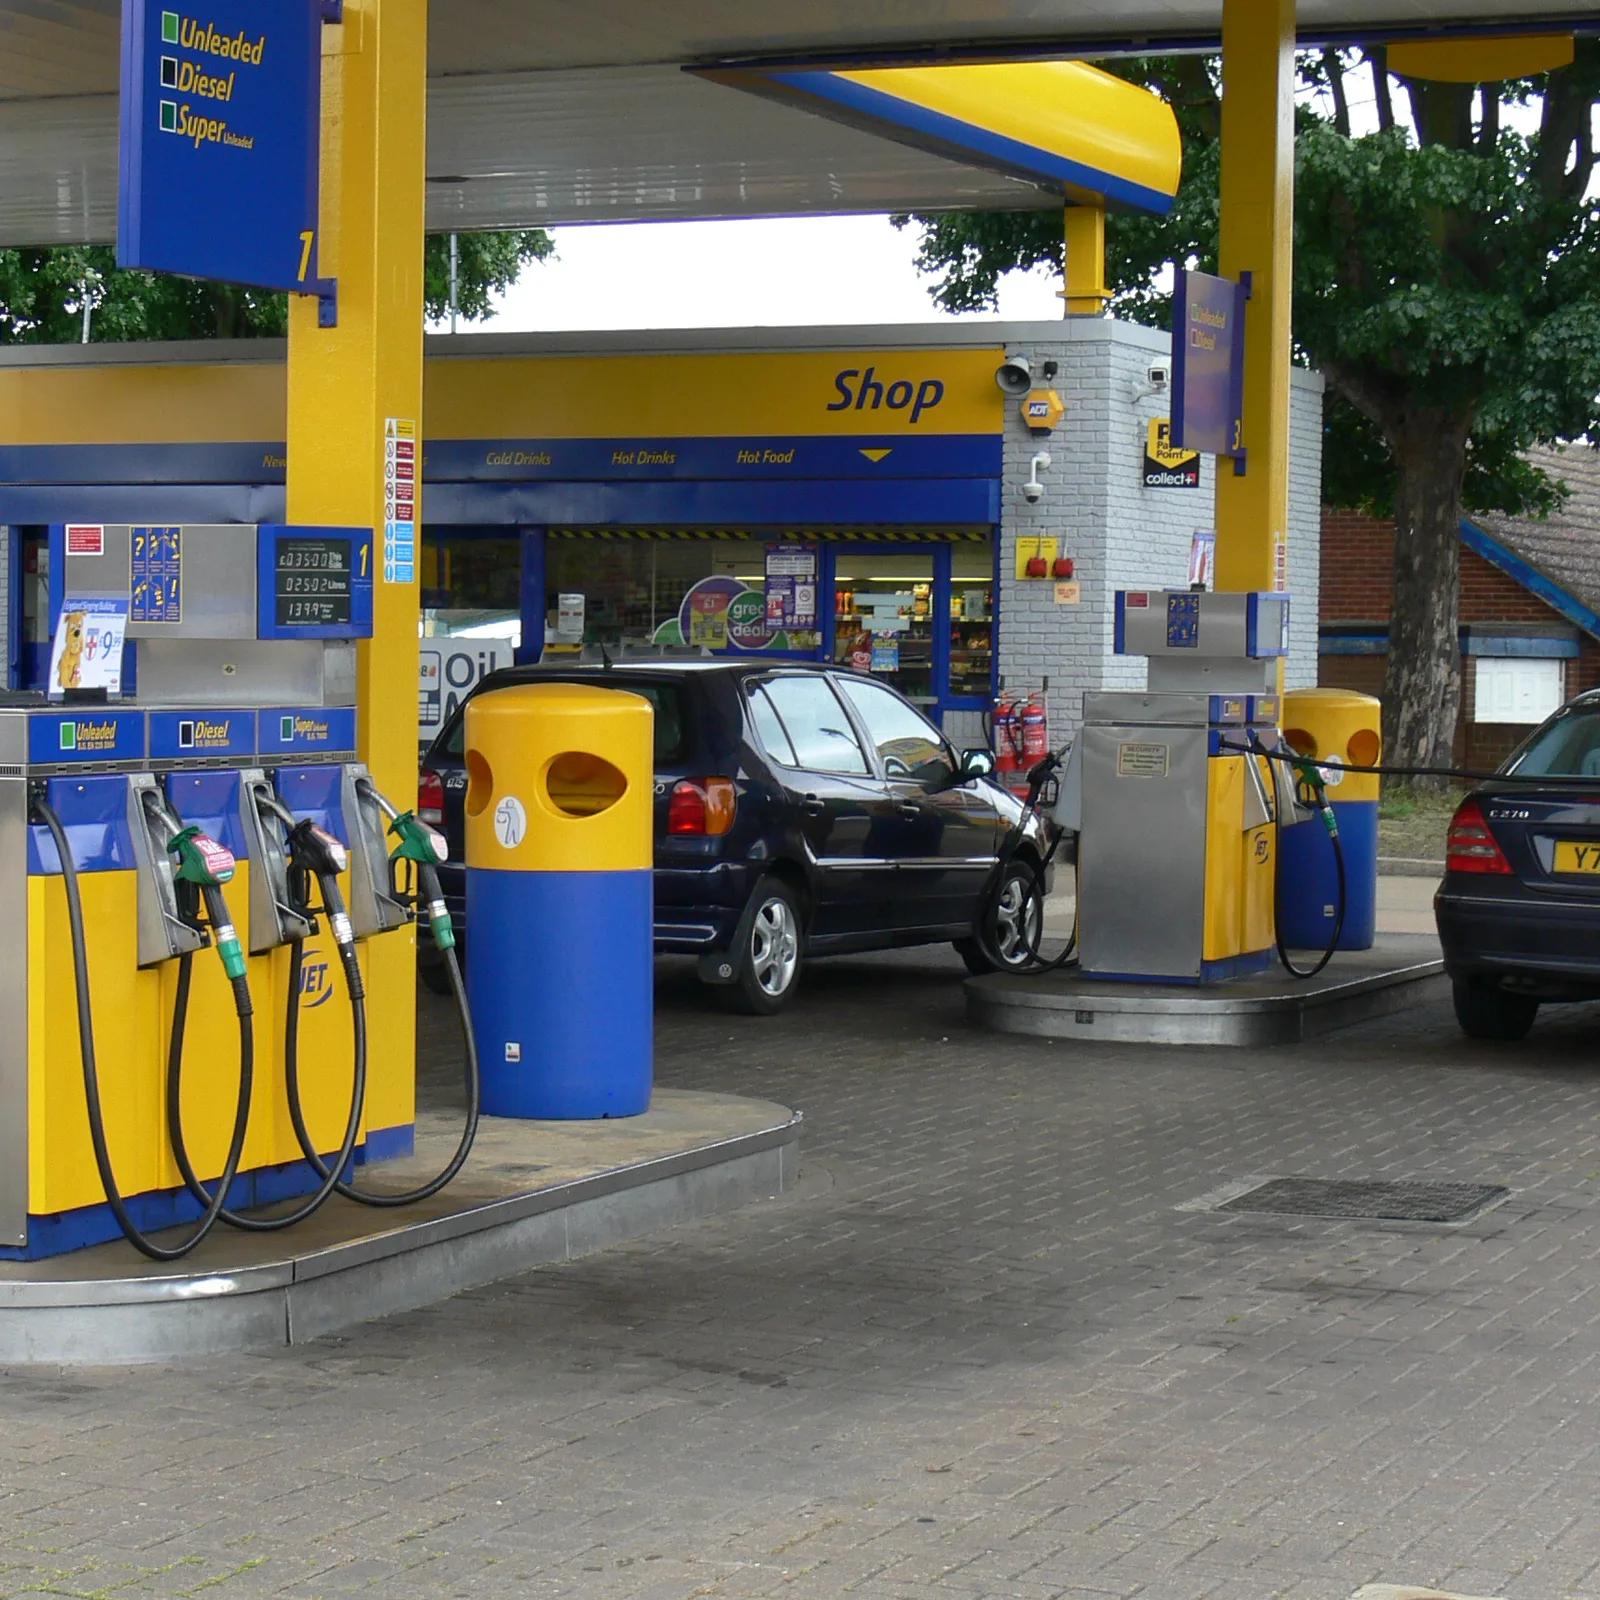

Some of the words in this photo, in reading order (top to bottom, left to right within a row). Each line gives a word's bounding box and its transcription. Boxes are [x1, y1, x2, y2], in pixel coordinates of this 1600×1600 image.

[179, 18, 265, 65] Unleaded
[178, 61, 235, 102] Diesel
[176, 104, 226, 148] Super
[223, 132, 254, 149] Unleaded
[297, 230, 314, 282] 1
[826, 367, 944, 423] Shop
[1029, 404, 1049, 415] ADT
[1232, 419, 1241, 451] 3
[486, 452, 512, 466] Cold
[514, 451, 551, 465] Drinks
[611, 451, 634, 465] Hot
[636, 450, 676, 465] Drinks
[736, 449, 760, 464] Hot
[762, 448, 795, 464] Food
[1156, 449, 1184, 460] Point
[360, 544, 369, 577] 1
[732, 622, 772, 637] deals
[445, 651, 497, 688] Oil
[77, 720, 117, 741] Unleaded
[195, 720, 230, 739] Diesel
[294, 716, 313, 737] Super
